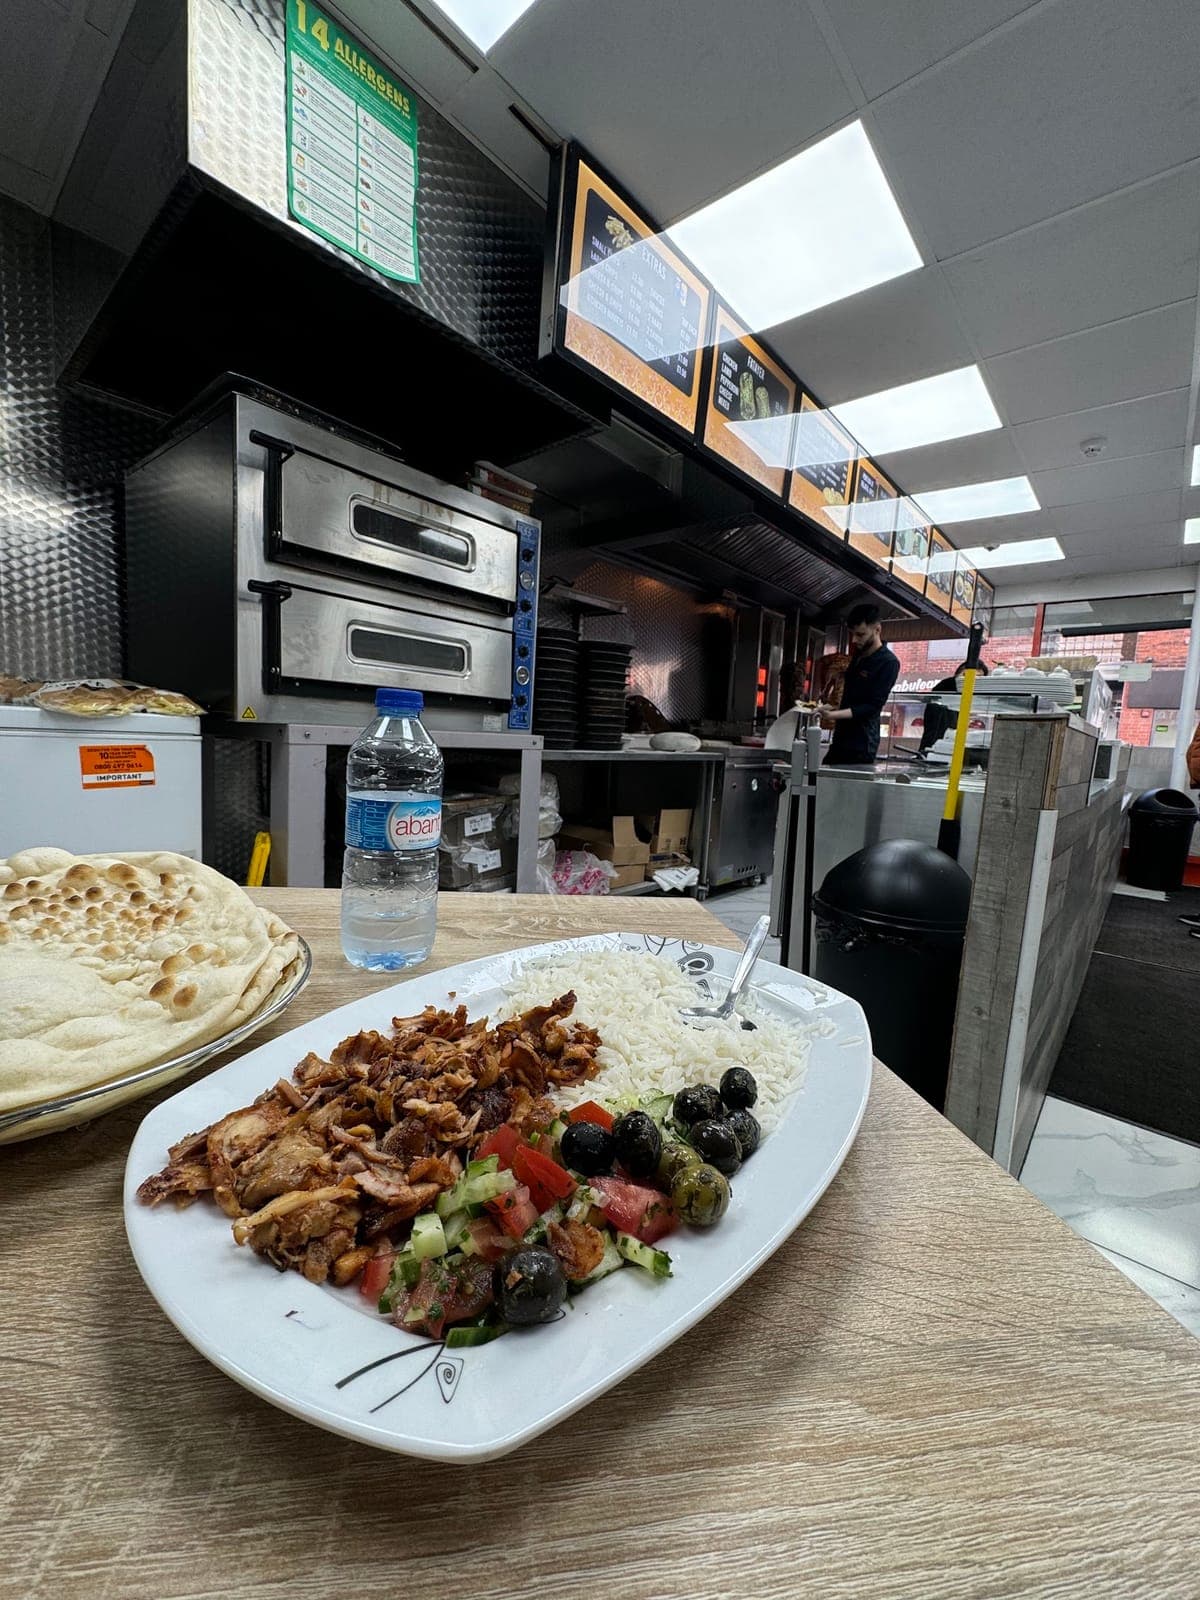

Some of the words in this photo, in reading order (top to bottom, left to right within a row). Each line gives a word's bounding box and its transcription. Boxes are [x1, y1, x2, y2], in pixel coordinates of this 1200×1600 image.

[296, 0, 330, 52] 14
[334, 37, 410, 112] ALLERGENS
[641, 246, 666, 280] EXTRAS
